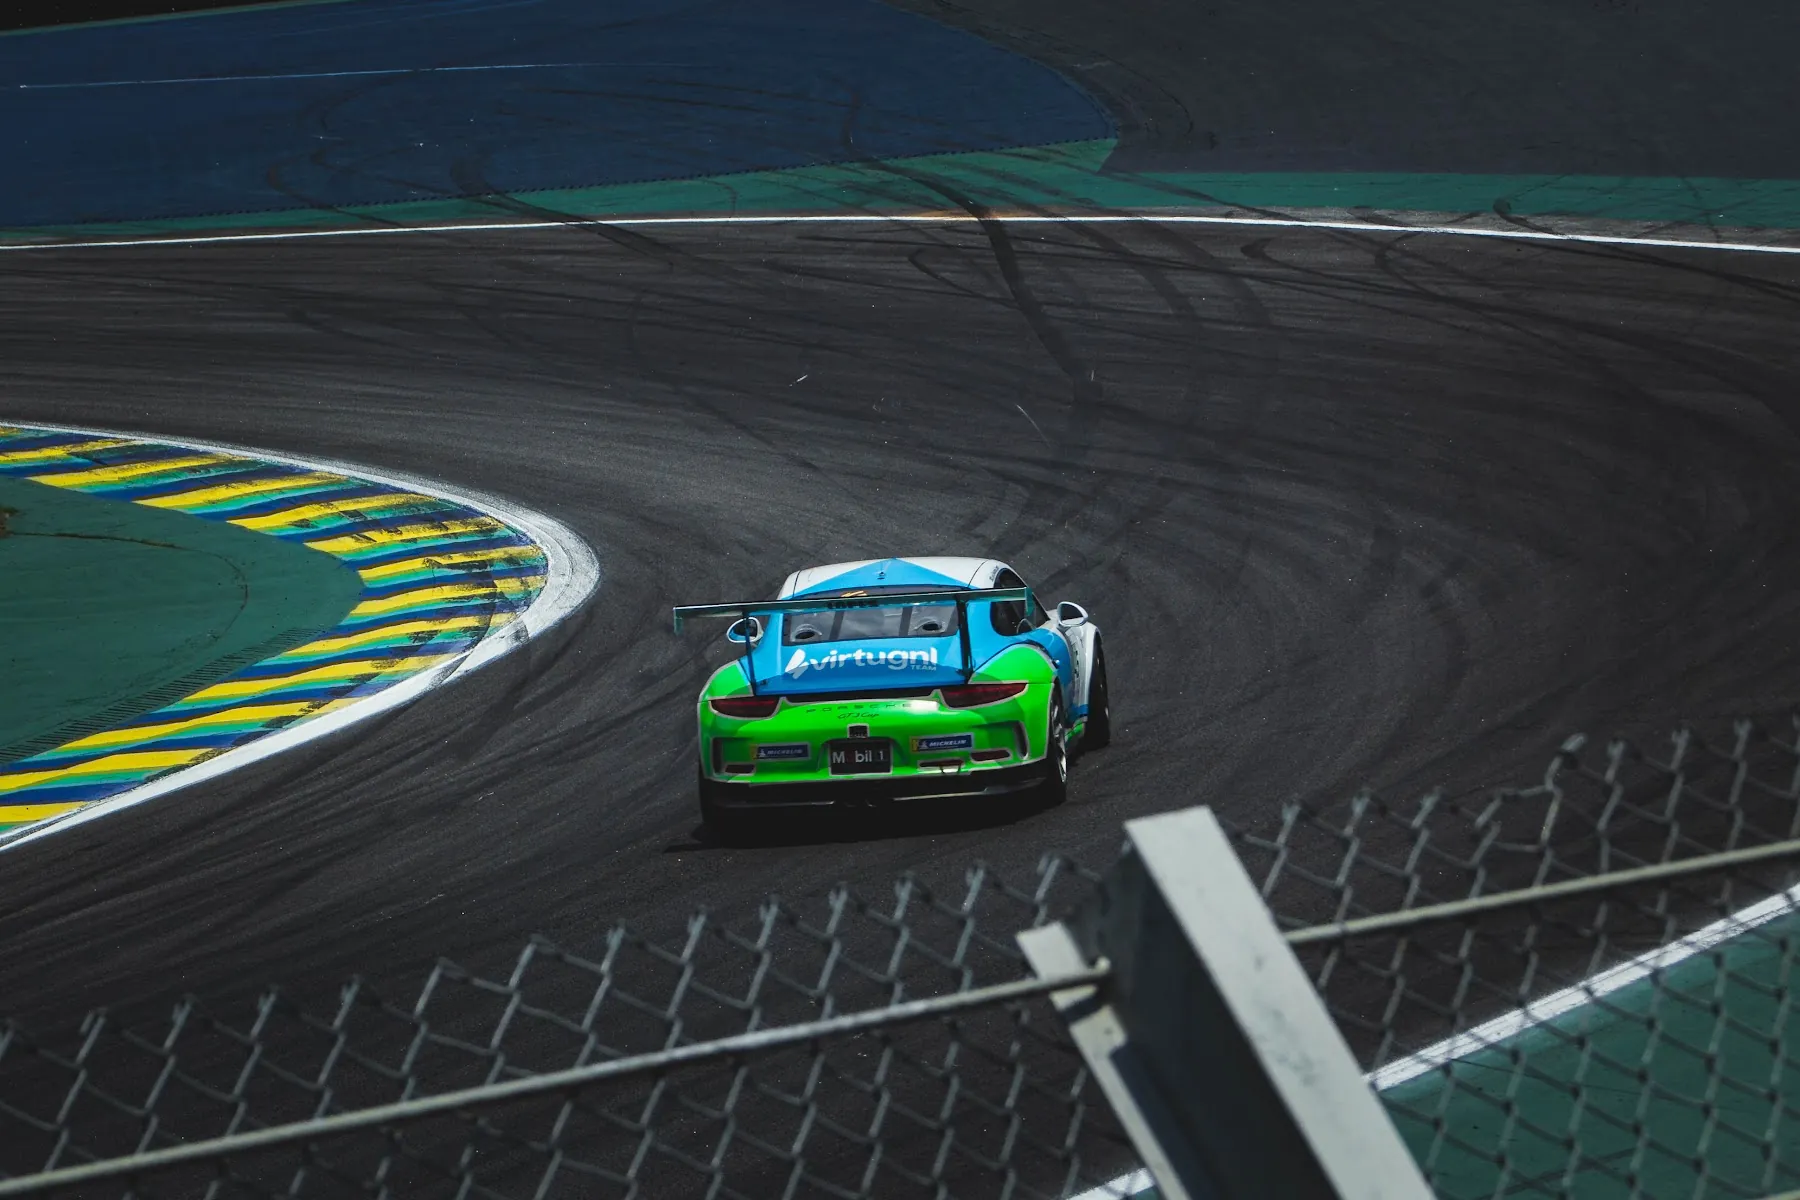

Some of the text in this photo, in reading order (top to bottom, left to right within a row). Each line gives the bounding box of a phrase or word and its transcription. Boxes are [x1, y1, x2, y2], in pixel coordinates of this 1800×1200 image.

[806, 703, 912, 713] PORSCHE
[928, 739, 967, 747] MICHELIN
[832, 750, 873, 764] Mbil
